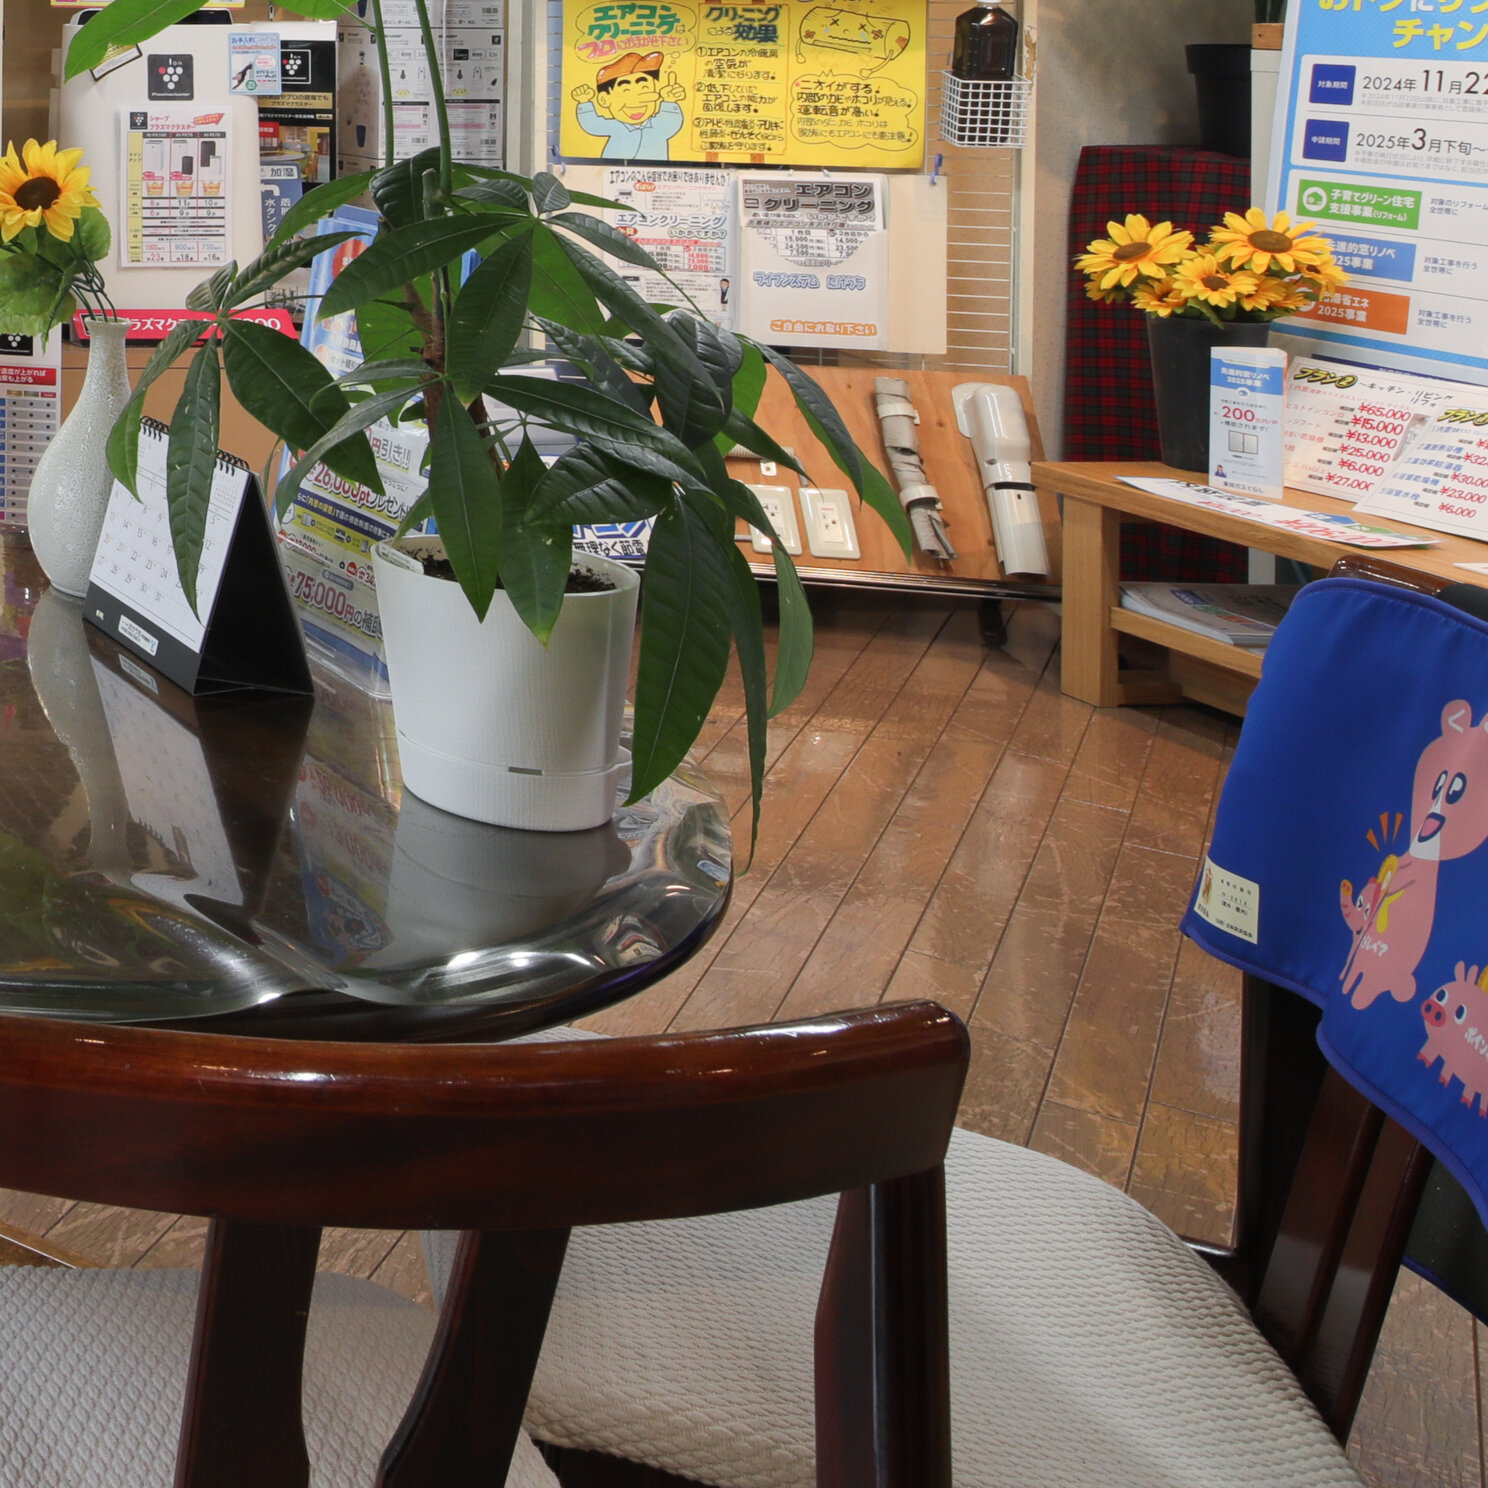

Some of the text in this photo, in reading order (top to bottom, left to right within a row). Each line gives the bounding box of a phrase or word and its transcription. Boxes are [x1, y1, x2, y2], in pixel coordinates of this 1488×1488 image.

[593, 2, 680, 23] エアコン
[705, 5, 784, 24] クリーニング
[707, 24, 779, 44] による効果
[704, 58, 752, 69] の空気が
[1316, 80, 1349, 90] 対象期間
[149, 114, 170, 122] シャープ
[149, 123, 196, 131] プラズマクラスター
[1310, 135, 1341, 146] 申請期間
[270, 167, 295, 178] 加湿
[795, 183, 873, 199] エアコン
[1330, 188, 1415, 209] 子育てグリーン住宅
[763, 198, 874, 214] クリーニング
[1429, 206, 1459, 216] 全世帯に
[617, 213, 727, 227] エアコンクリーニング
[1423, 256, 1478, 270] 対象工事を行う
[1423, 264, 1454, 275] 全世帯に
[753, 271, 821, 289] ライフシステム
[1317, 304, 1369, 323] 2025事業
[1418, 309, 1473, 325] 対象工事を行う
[770, 319, 877, 336] ご自由にお取り下さい
[1416, 317, 1448, 329] 全世帯に
[1226, 376, 1263, 388] 2025事業
[1221, 405, 1256, 422] 200
